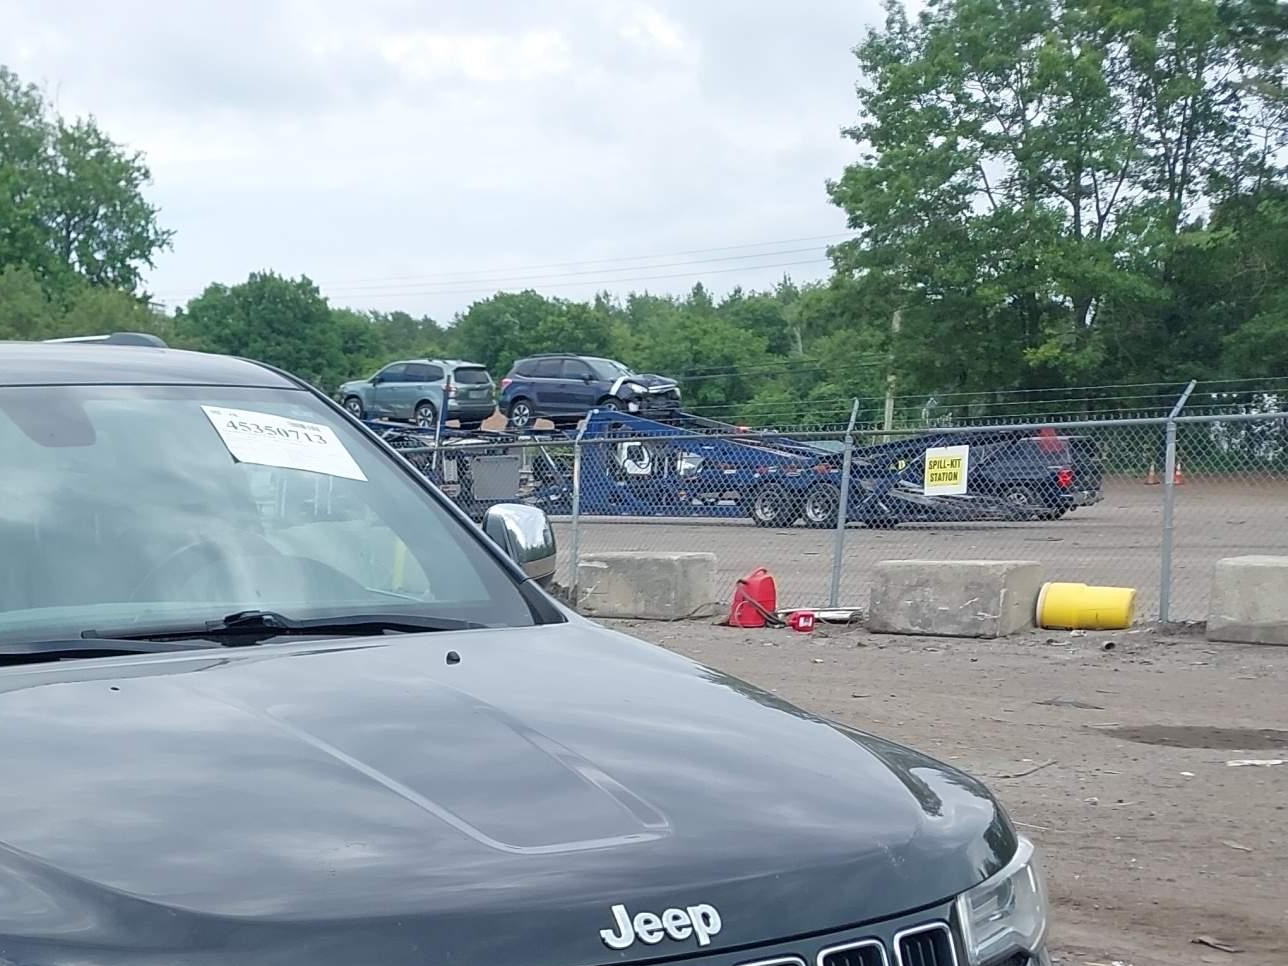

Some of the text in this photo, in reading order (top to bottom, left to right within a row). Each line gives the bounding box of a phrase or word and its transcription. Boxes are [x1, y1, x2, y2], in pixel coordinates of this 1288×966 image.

[226, 420, 328, 445] 45350713
[928, 458, 961, 469] SPILL-KIT
[929, 472, 959, 482] STATION
[599, 903, 722, 948] Jeep
